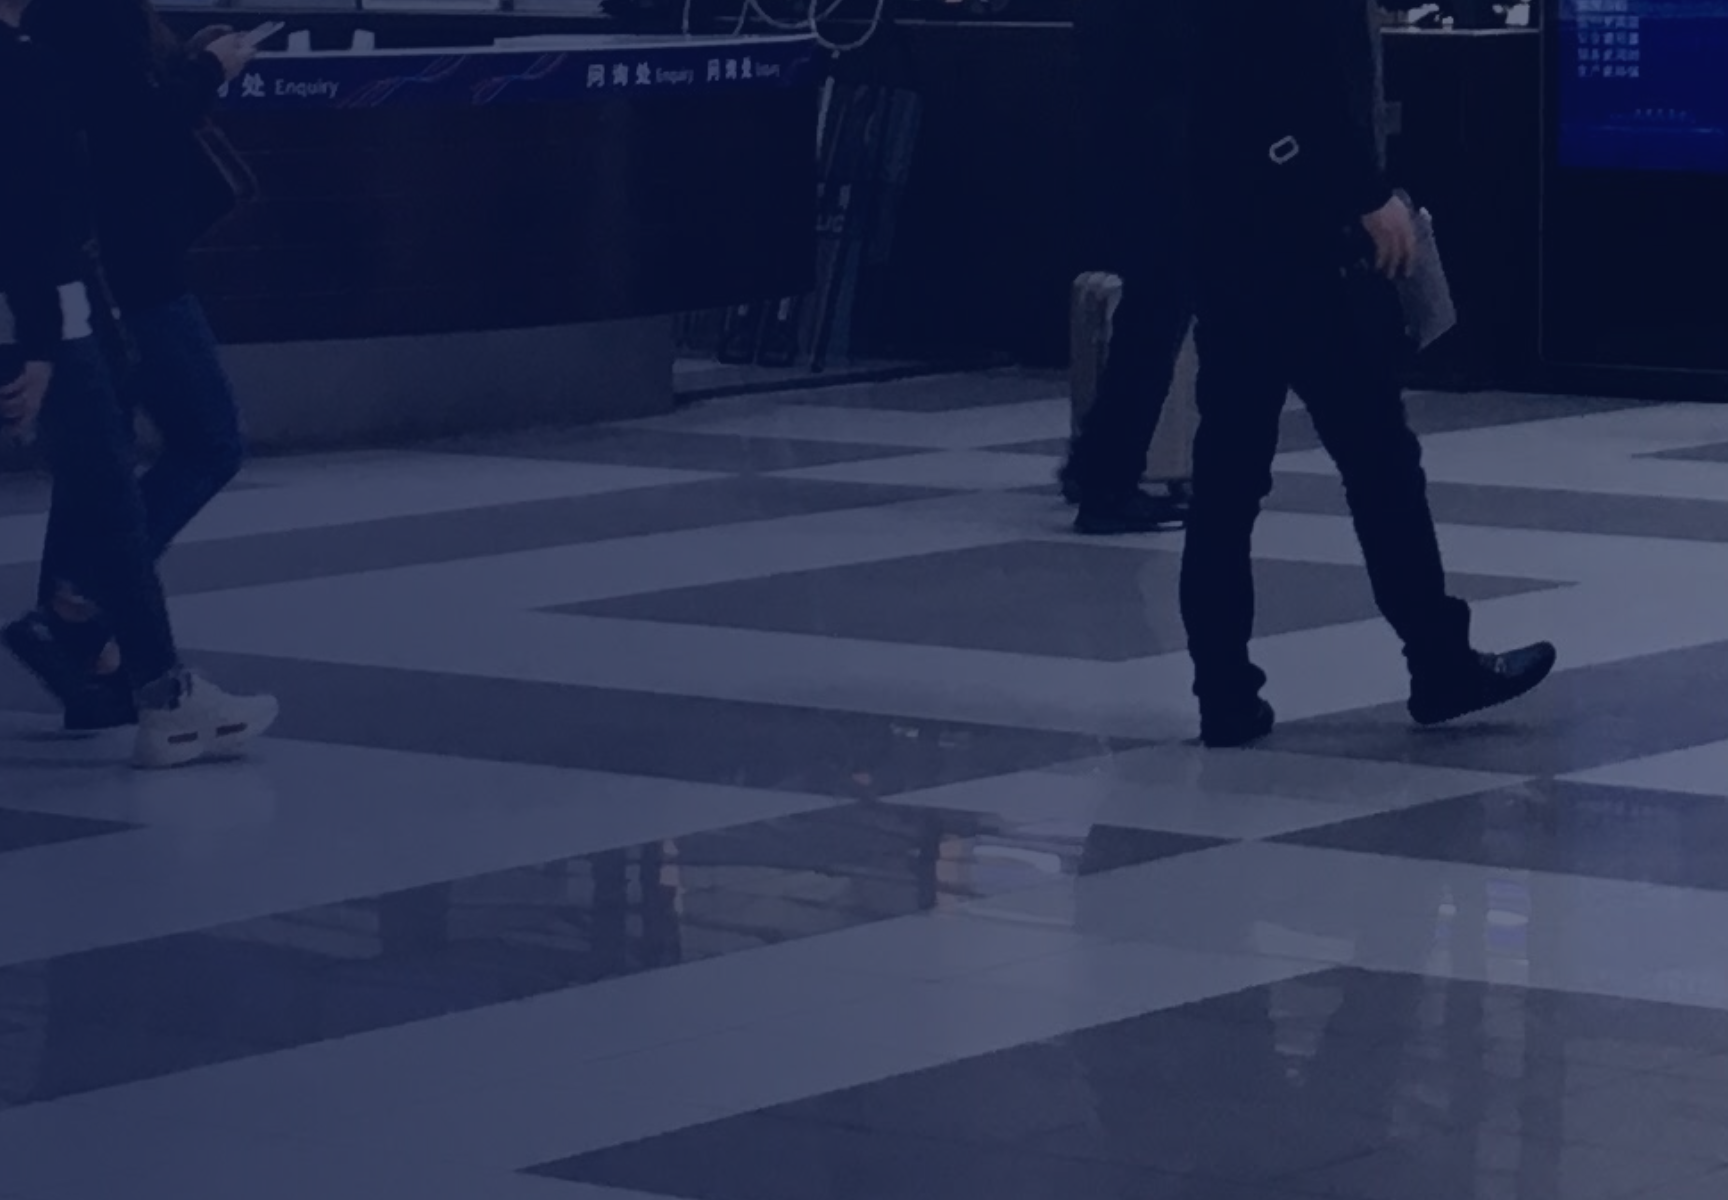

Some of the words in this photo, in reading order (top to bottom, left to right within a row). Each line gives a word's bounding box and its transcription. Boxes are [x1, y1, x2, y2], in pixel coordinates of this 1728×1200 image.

[273, 77, 340, 99] Enquiry
[586, 61, 653, 89] 问询处
